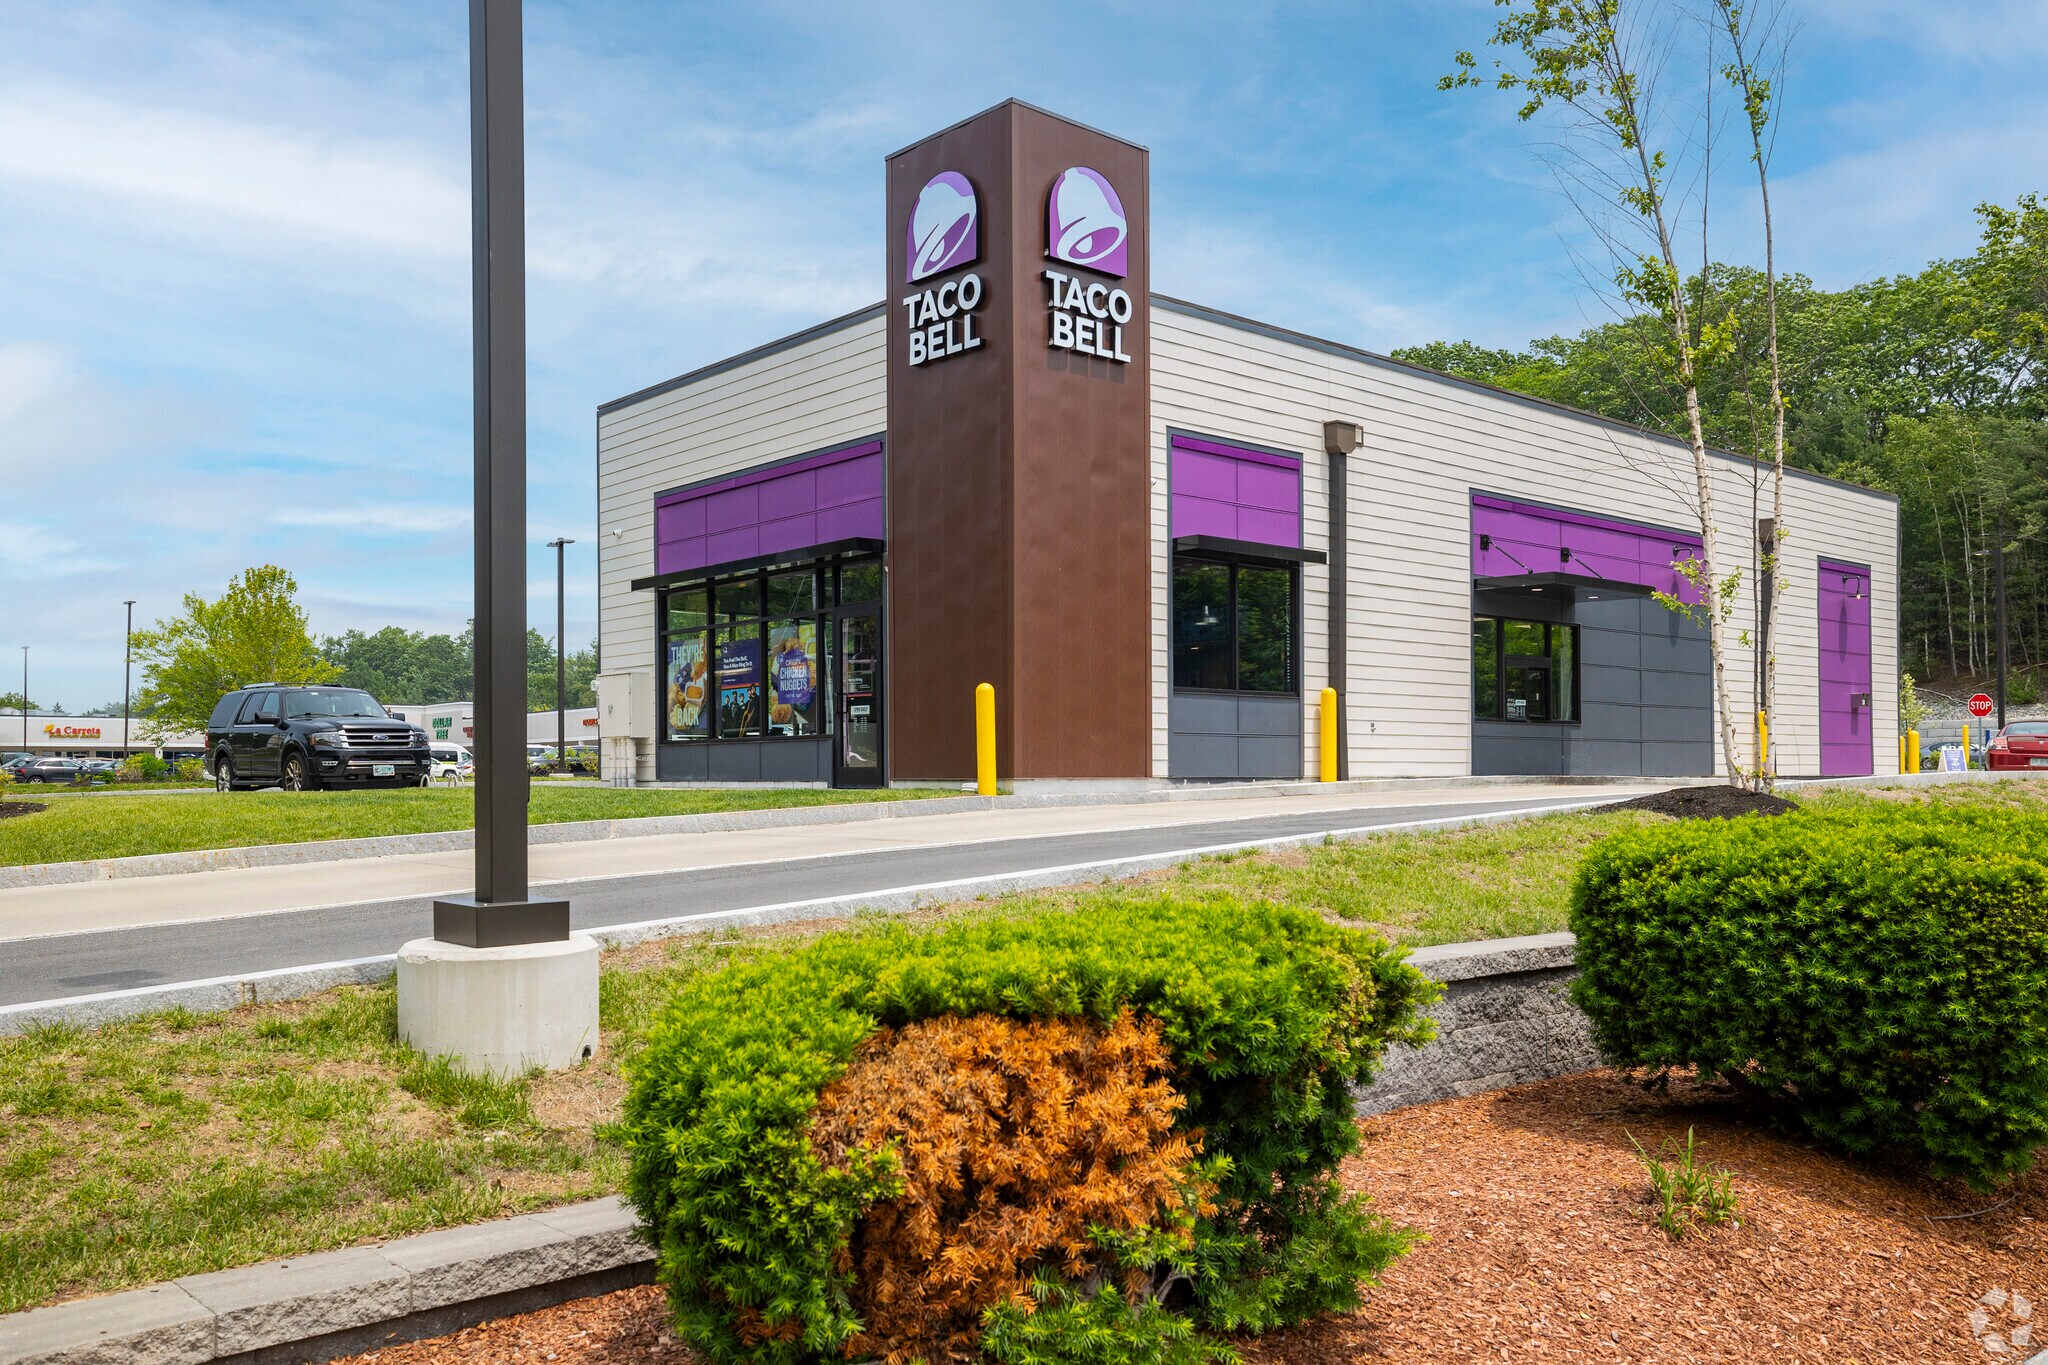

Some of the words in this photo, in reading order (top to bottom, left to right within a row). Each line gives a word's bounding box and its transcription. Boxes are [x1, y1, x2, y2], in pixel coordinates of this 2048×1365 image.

[903, 273, 983, 329] TACO
[1044, 270, 1133, 324] TACO
[909, 314, 981, 366] BELL
[1053, 311, 1132, 363] BELL
[671, 644, 704, 664] THEY'RE
[785, 658, 802, 666] CRISPY
[780, 665, 807, 679] CHICKEN
[780, 678, 808, 691] NUGGETS
[1970, 702, 1991, 710] STOP
[432, 717, 453, 728] DOLLAR
[677, 707, 700, 727] BACK
[64, 725, 101, 735] Carreta
[435, 729, 449, 740] TREE
